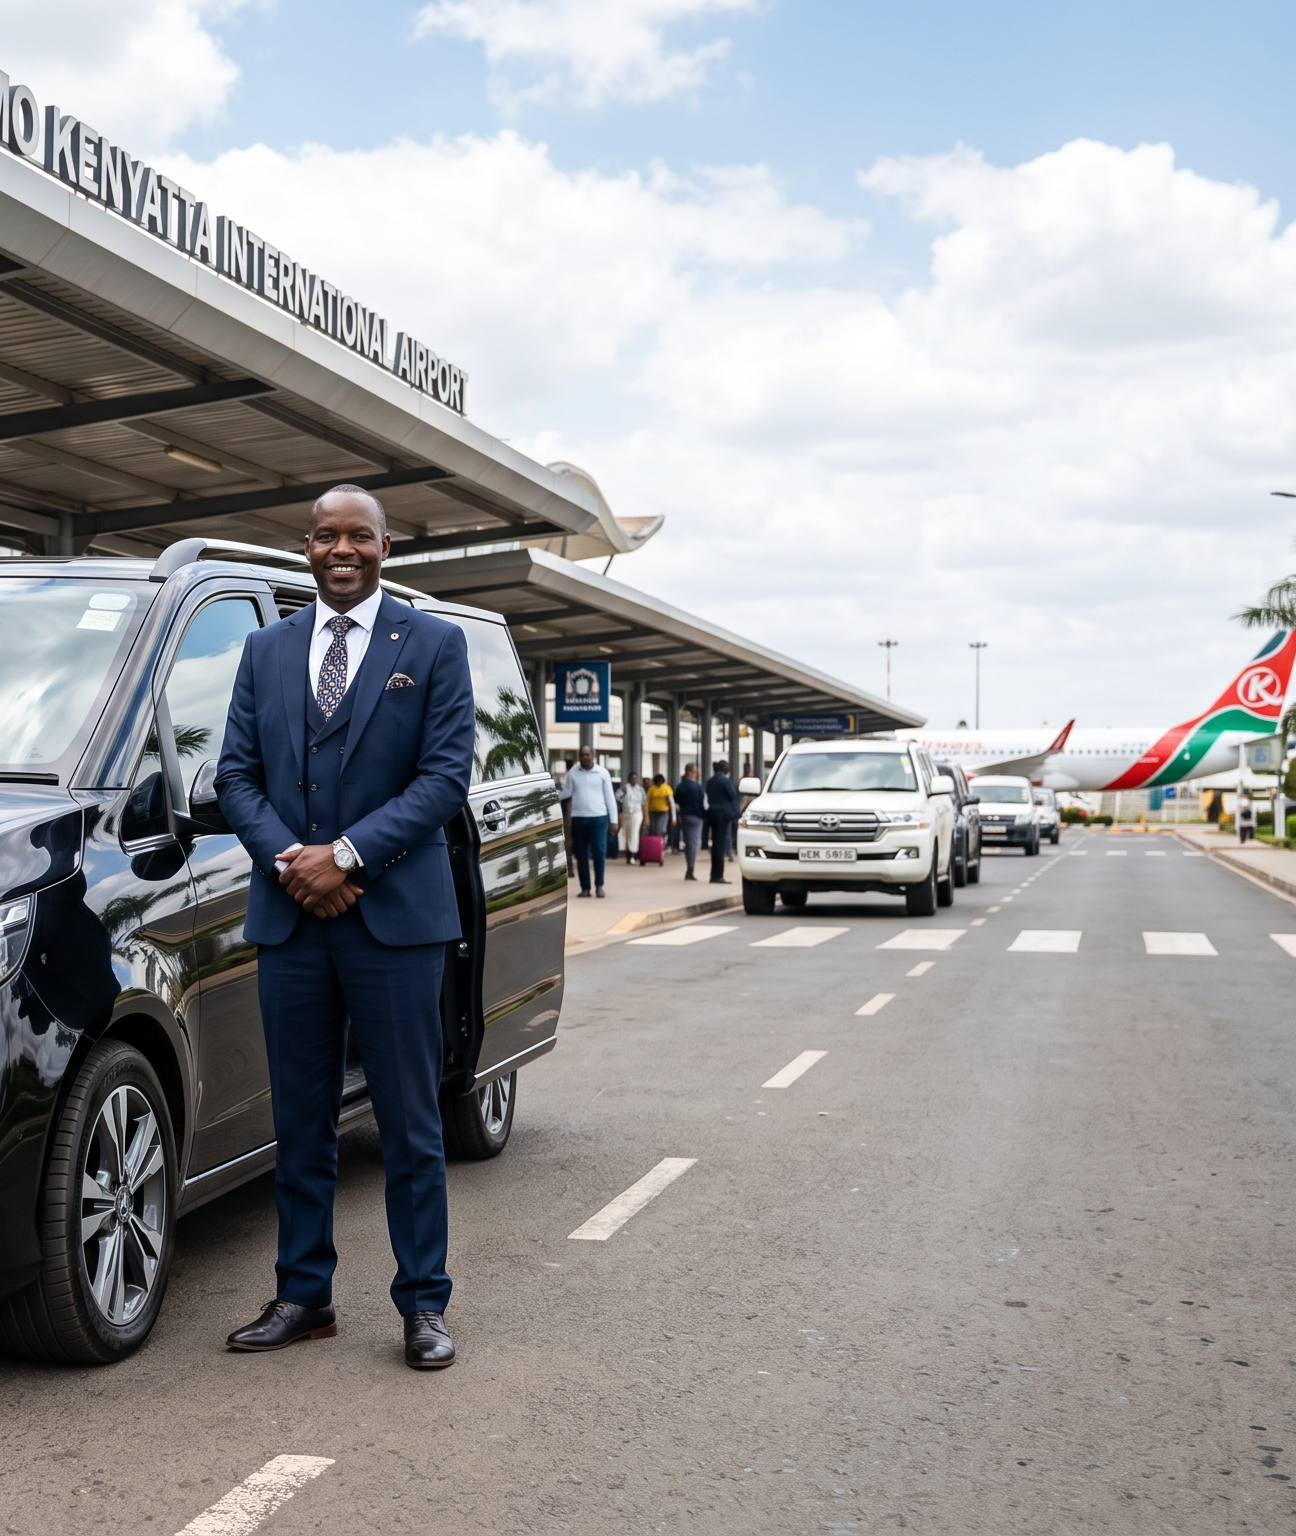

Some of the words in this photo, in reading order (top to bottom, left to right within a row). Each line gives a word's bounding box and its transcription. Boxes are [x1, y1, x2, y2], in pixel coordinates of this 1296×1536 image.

[44, 105, 213, 263] KENYATTA
[216, 215, 395, 369] INTERNATIONAL
[393, 332, 469, 416] AIRPORT
